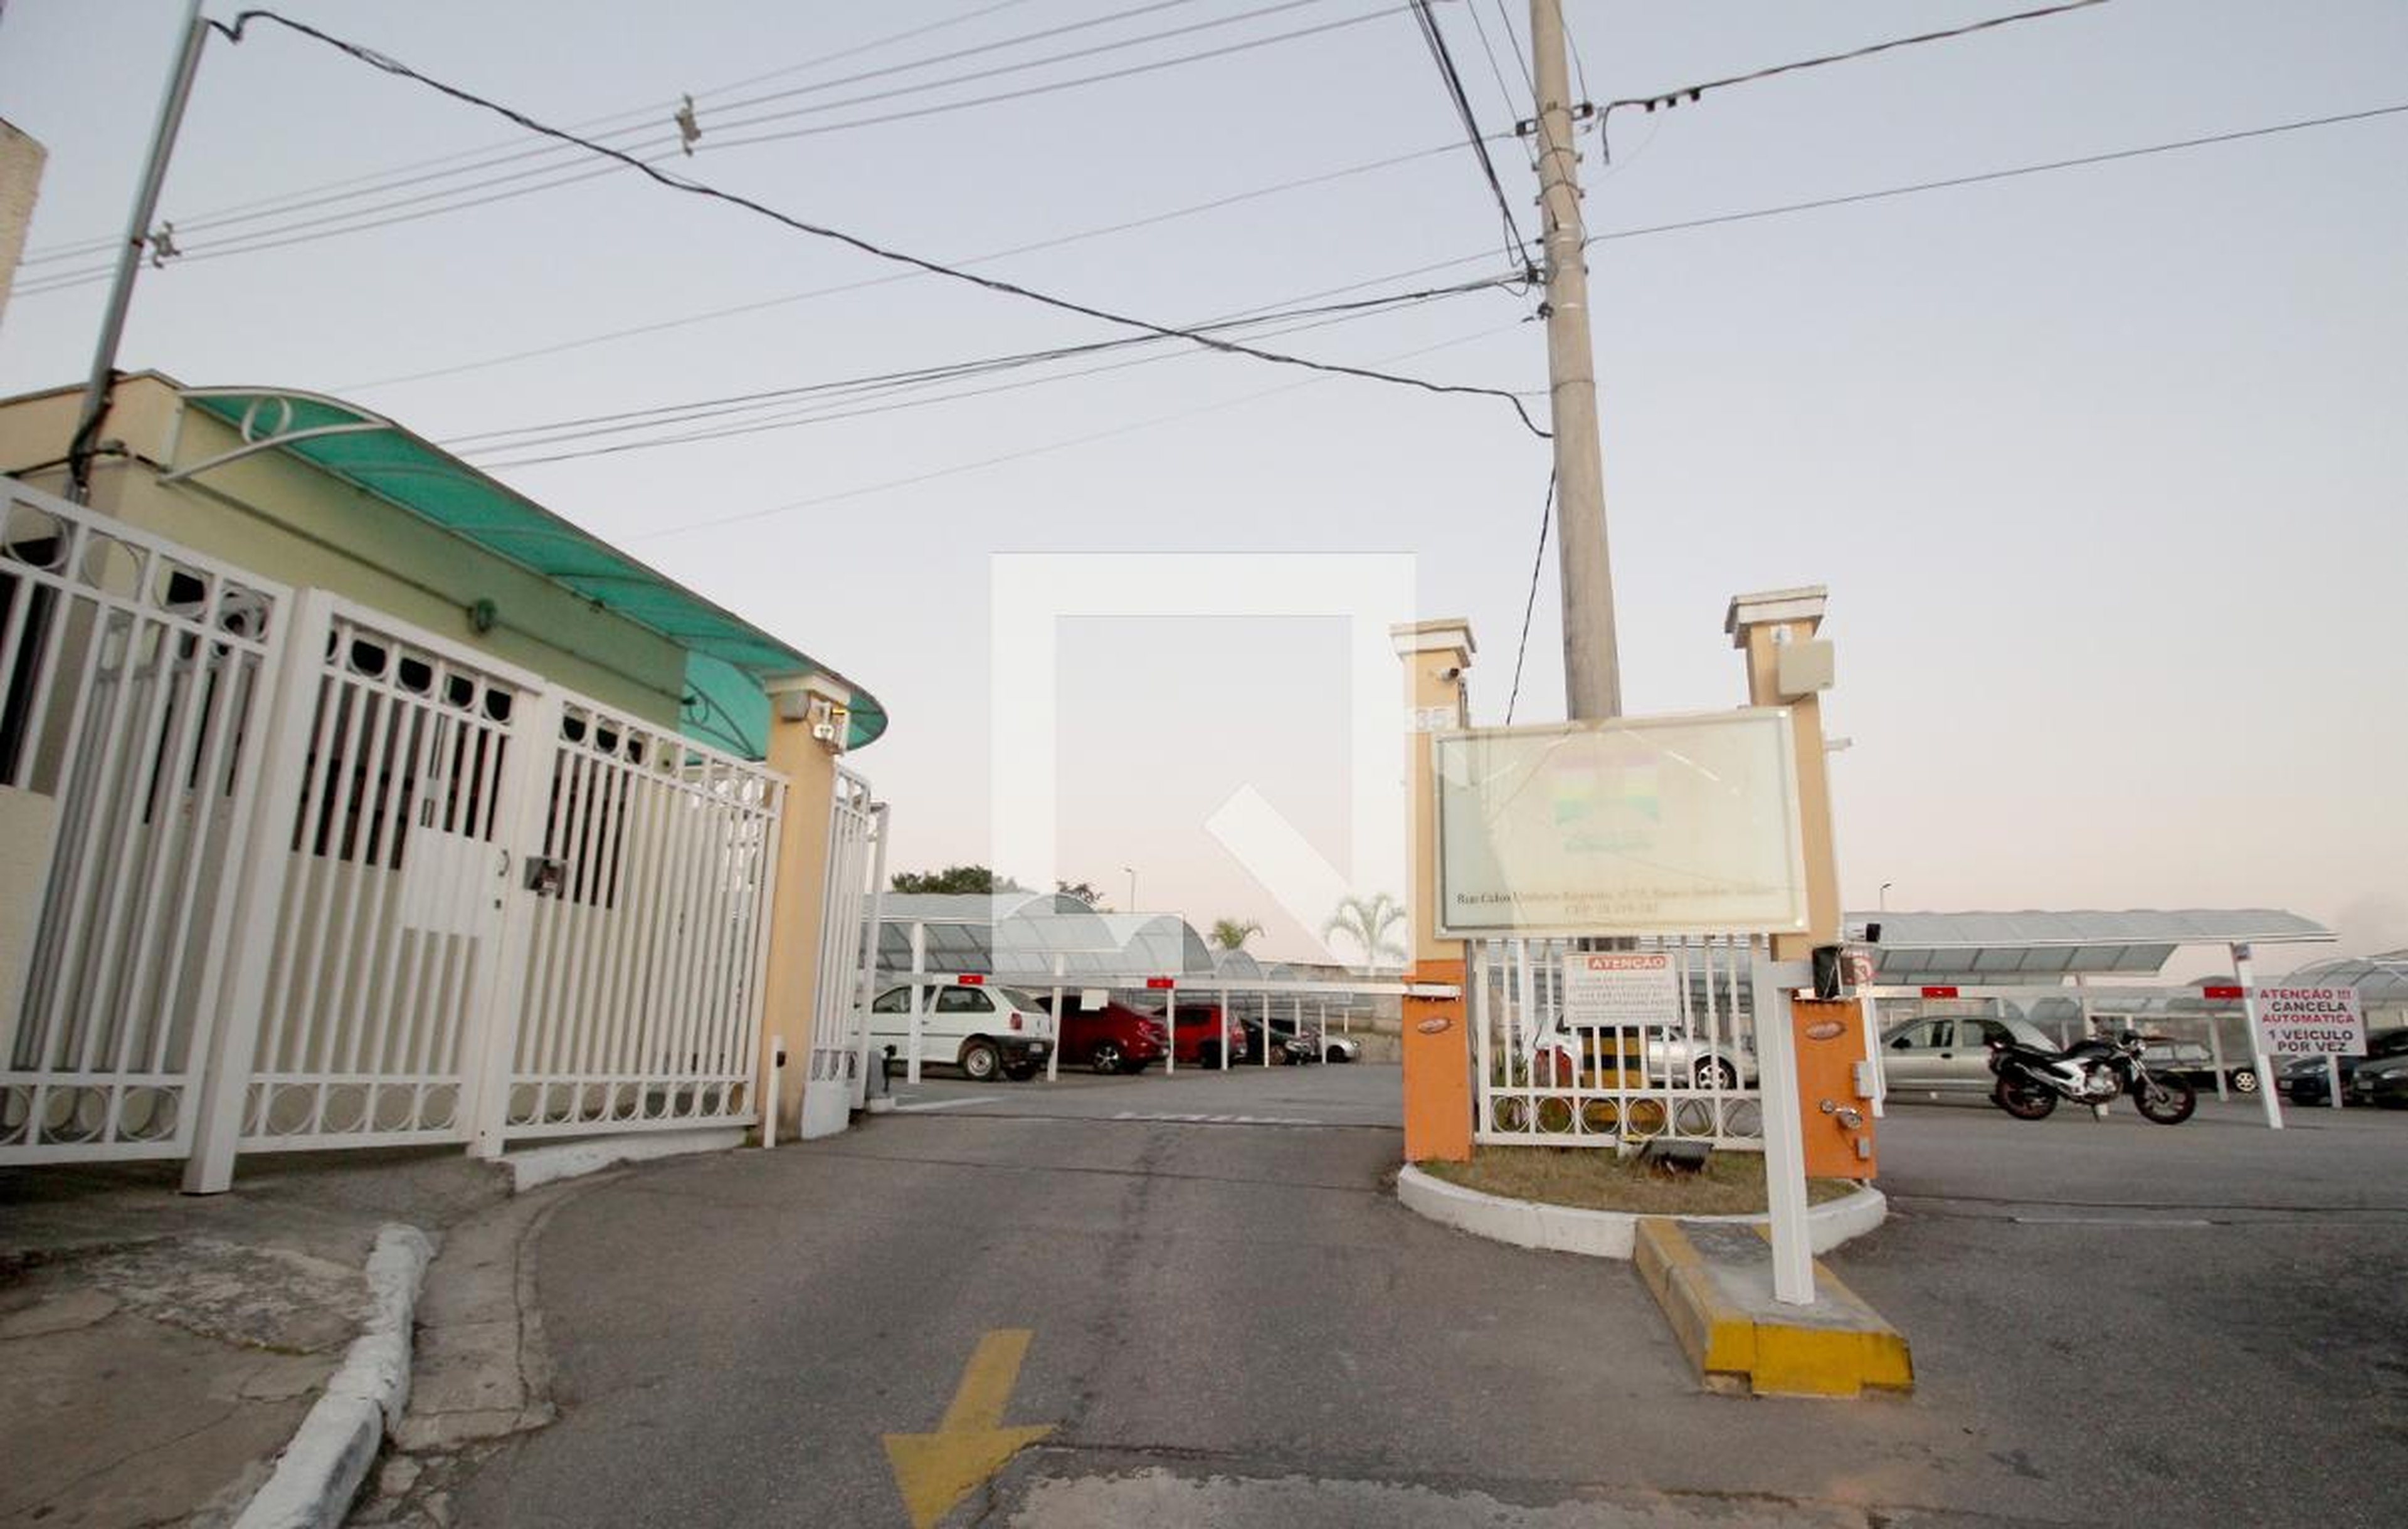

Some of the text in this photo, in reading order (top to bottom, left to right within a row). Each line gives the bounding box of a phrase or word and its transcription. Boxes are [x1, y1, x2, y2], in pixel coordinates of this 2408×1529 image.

[2271, 1001, 2347, 1012] CANCELA
[2268, 1029, 2276, 1039] 1
[2278, 1041, 2347, 1052] POR VEZ
